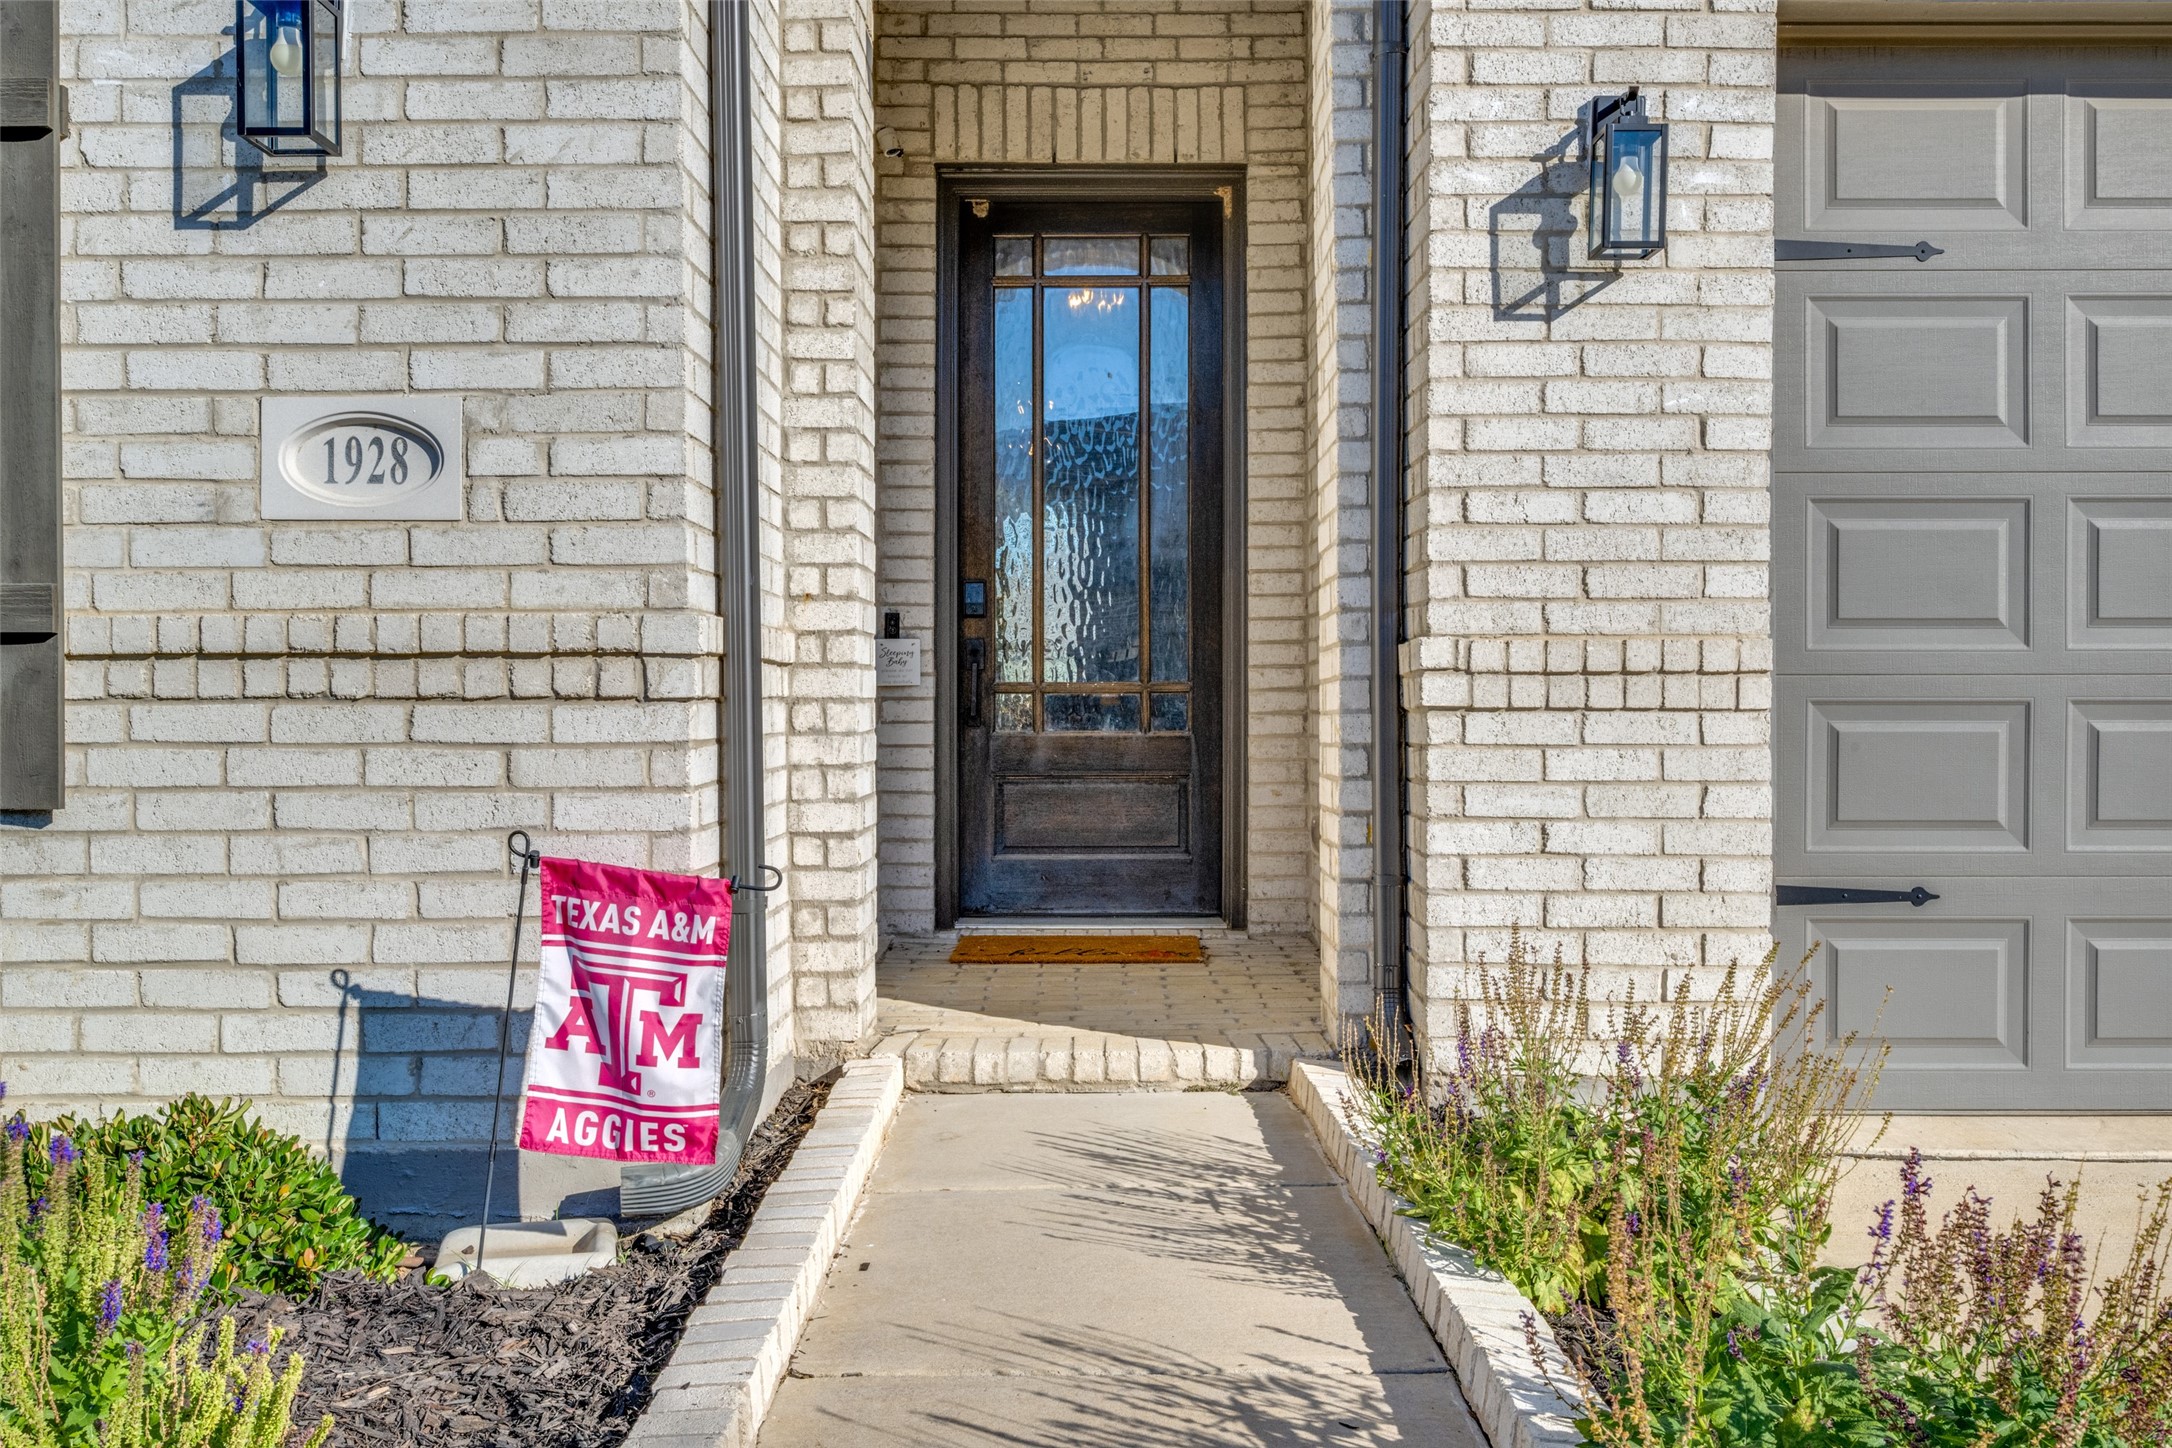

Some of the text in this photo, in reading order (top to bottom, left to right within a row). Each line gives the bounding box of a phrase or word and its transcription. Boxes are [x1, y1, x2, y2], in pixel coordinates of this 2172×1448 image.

[323, 435, 409, 485] 1928
[879, 647, 914, 658] Sleeping
[886, 656, 907, 667] Baby
[551, 894, 717, 945] TEXAS A&M
[545, 1106, 687, 1153] AGGIES
